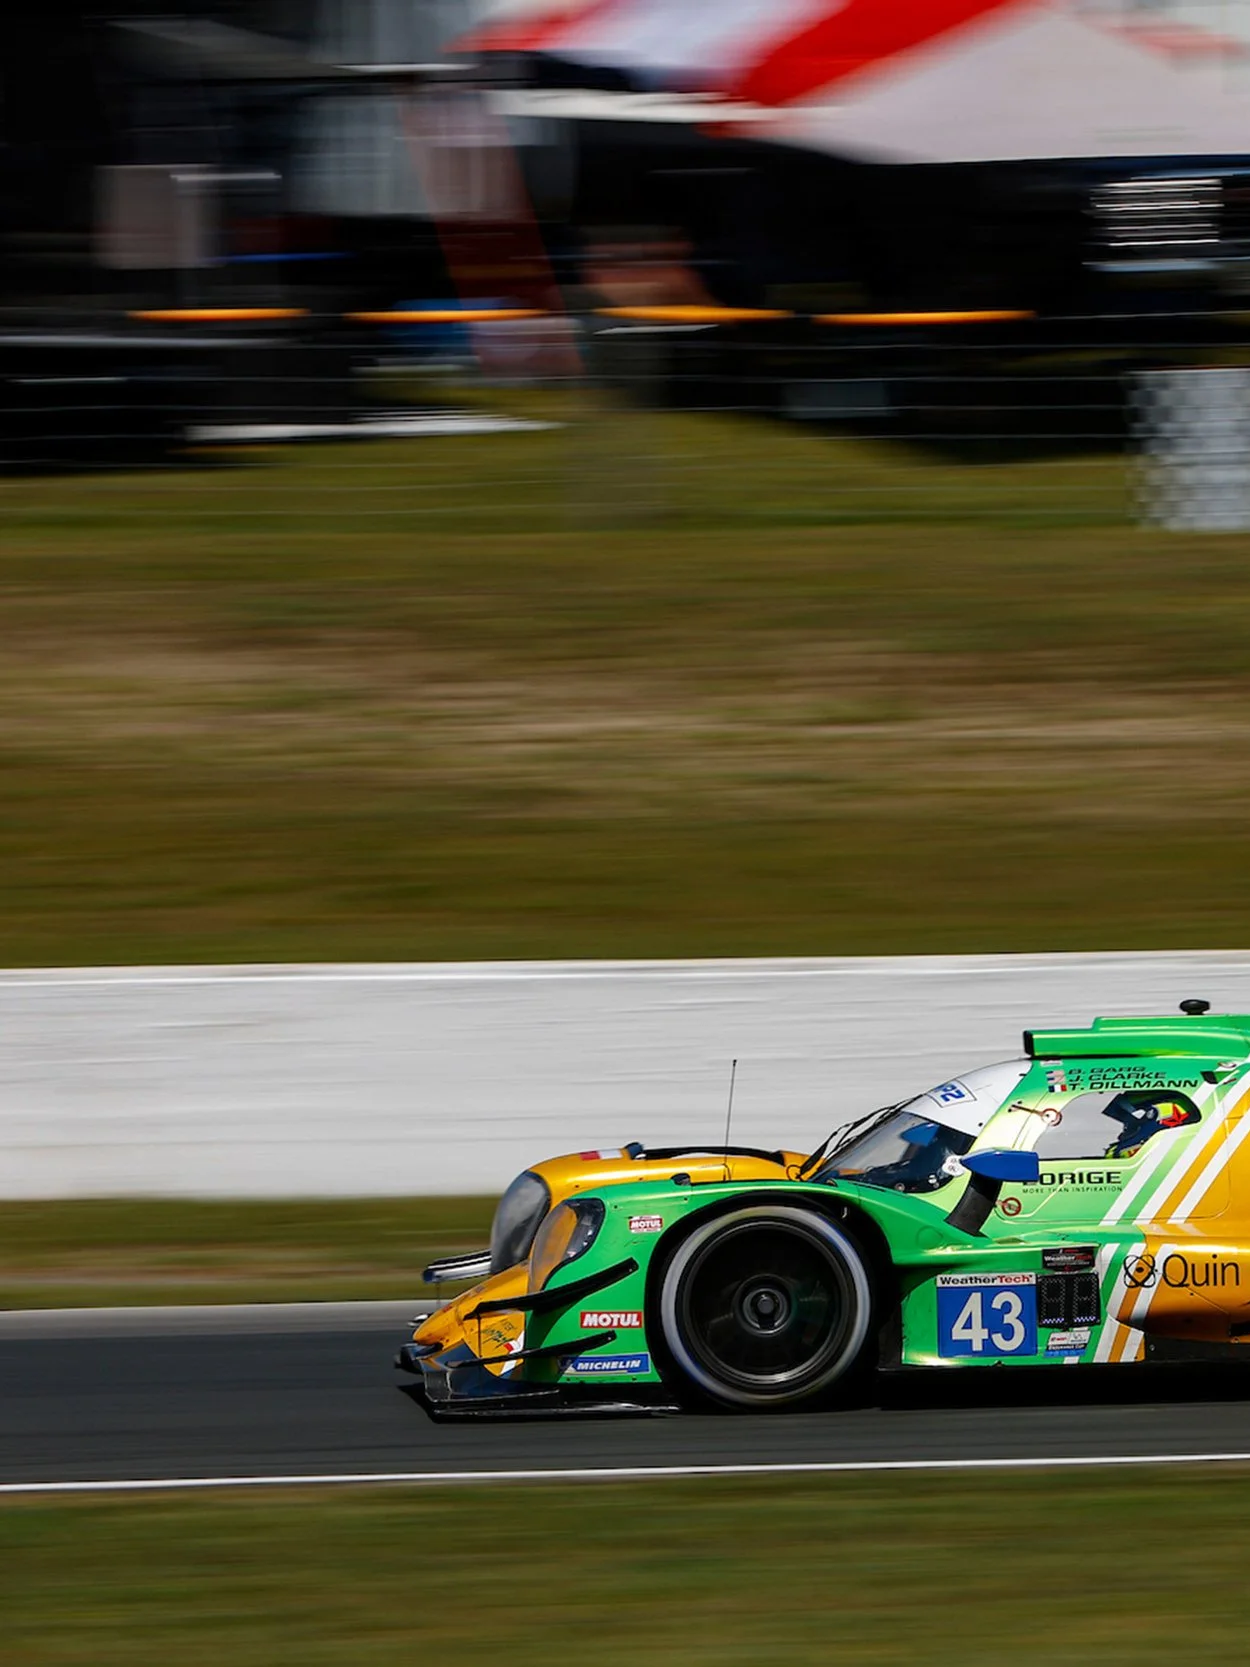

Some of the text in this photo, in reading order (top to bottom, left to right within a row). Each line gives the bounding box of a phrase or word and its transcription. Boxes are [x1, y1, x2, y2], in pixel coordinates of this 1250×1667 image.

[1090, 1066, 1146, 1074] GARG
[1068, 1072, 1167, 1083] J. CLARKE
[1069, 1079, 1199, 1091] T. DILLMANN
[1022, 1171, 1122, 1186] ORIGE
[630, 1219, 661, 1229] MOTUL
[1163, 1254, 1240, 1288] Quin
[940, 1274, 1032, 1285] WeatherTech
[582, 1313, 640, 1327] MOTUL
[951, 1291, 1025, 1352] 43
[576, 1359, 642, 1371] MICHELIN
